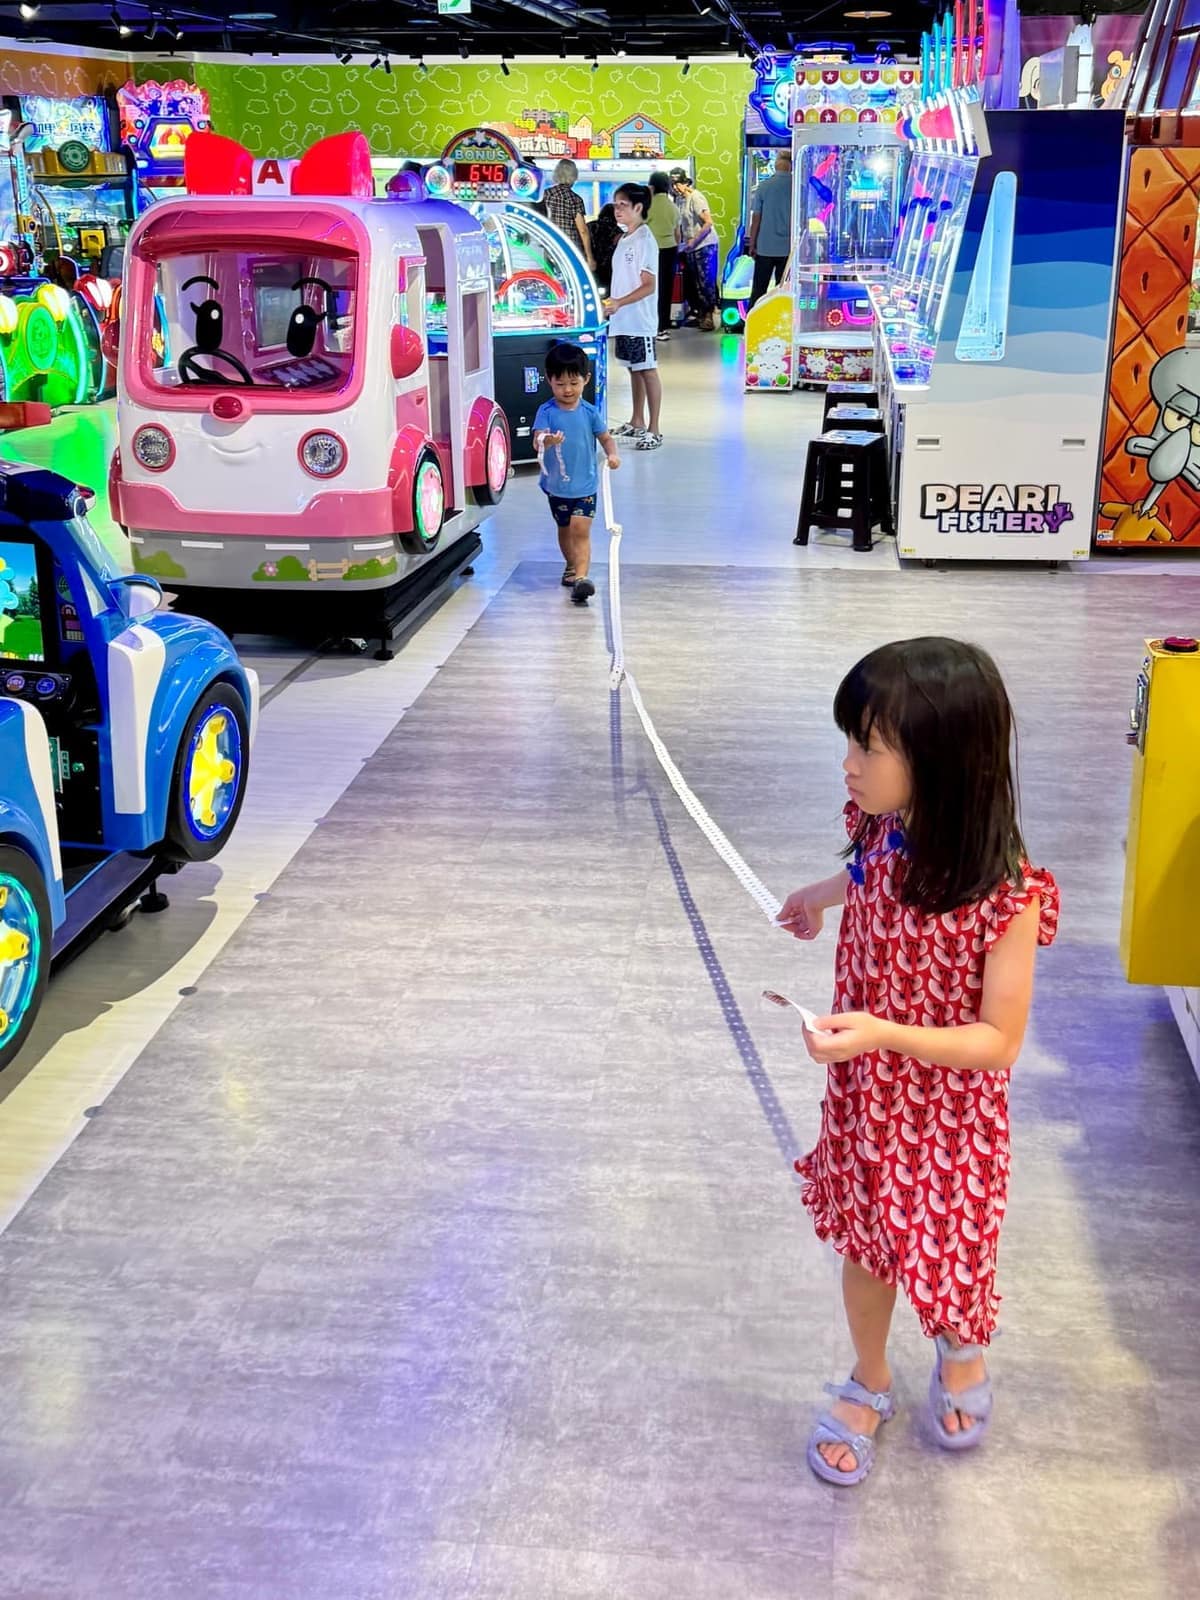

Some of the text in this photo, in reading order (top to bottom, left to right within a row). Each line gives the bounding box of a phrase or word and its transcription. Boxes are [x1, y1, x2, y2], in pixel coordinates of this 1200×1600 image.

[455, 149, 506, 160] BONUS
[256, 159, 285, 184] A
[470, 164, 504, 182] 646
[938, 503, 1074, 533] FISHERY
